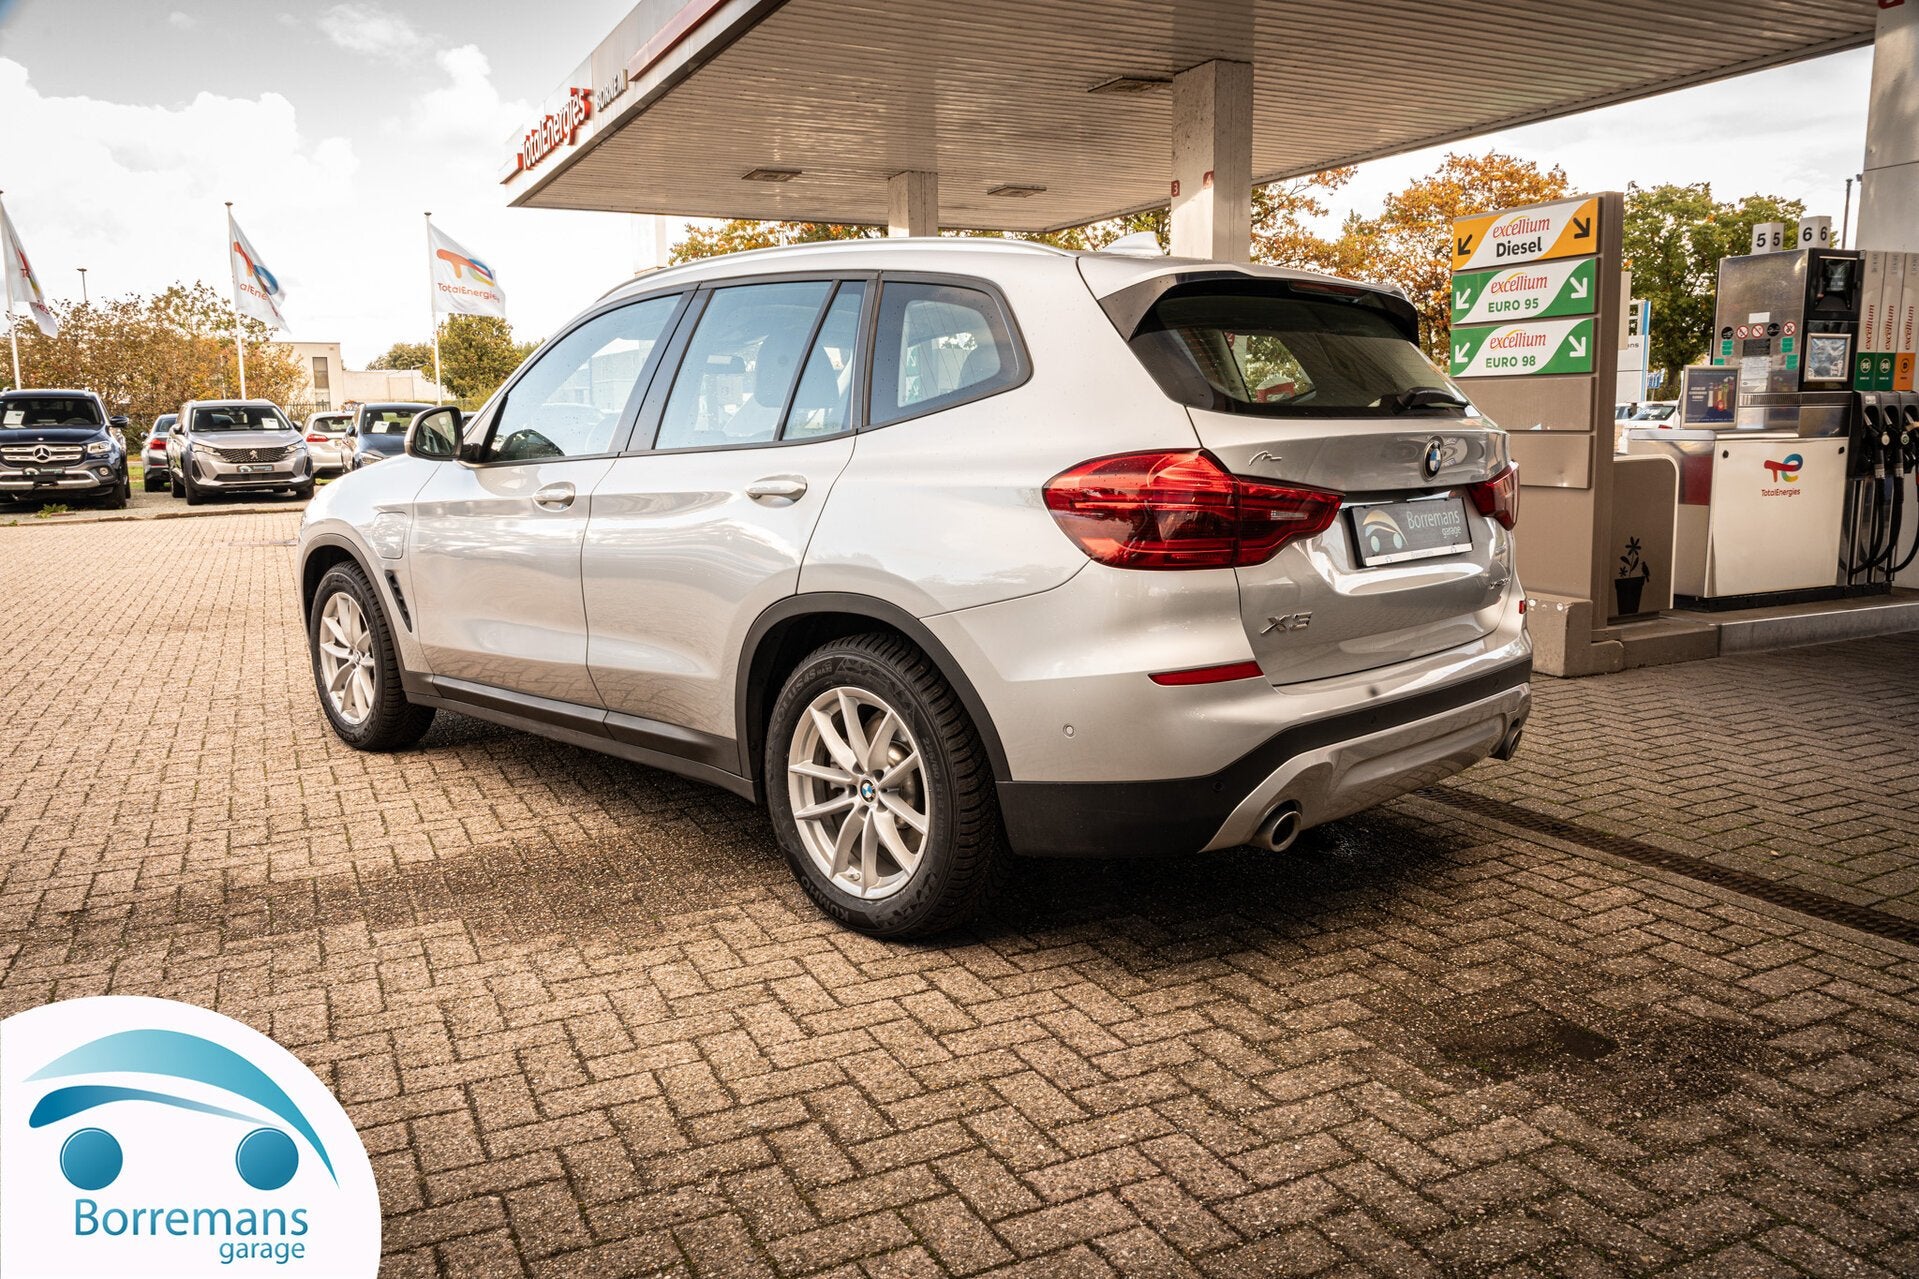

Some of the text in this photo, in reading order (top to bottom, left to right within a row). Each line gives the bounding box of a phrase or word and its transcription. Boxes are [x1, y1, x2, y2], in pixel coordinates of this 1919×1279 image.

[1492, 216, 1550, 239] excellium
[1802, 227, 1813, 241] 6
[1820, 226, 1828, 241] 6
[1496, 237, 1542, 258] Diesel
[1756, 233, 1766, 247] 5
[1772, 232, 1781, 246] 5
[1490, 274, 1548, 295] excellium
[1488, 298, 1539, 313] EURO 95
[1866, 304, 1875, 350] excellium
[1885, 305, 1895, 350] excellium
[1906, 305, 1915, 350] excellium
[1489, 332, 1547, 350] excellium
[1486, 355, 1536, 369] EURO 98
[1761, 488, 1800, 498] TotalEnergies
[1406, 509, 1460, 529] Borremans
[1441, 525, 1462, 539] garage
[800, 875, 849, 922] KUMHO
